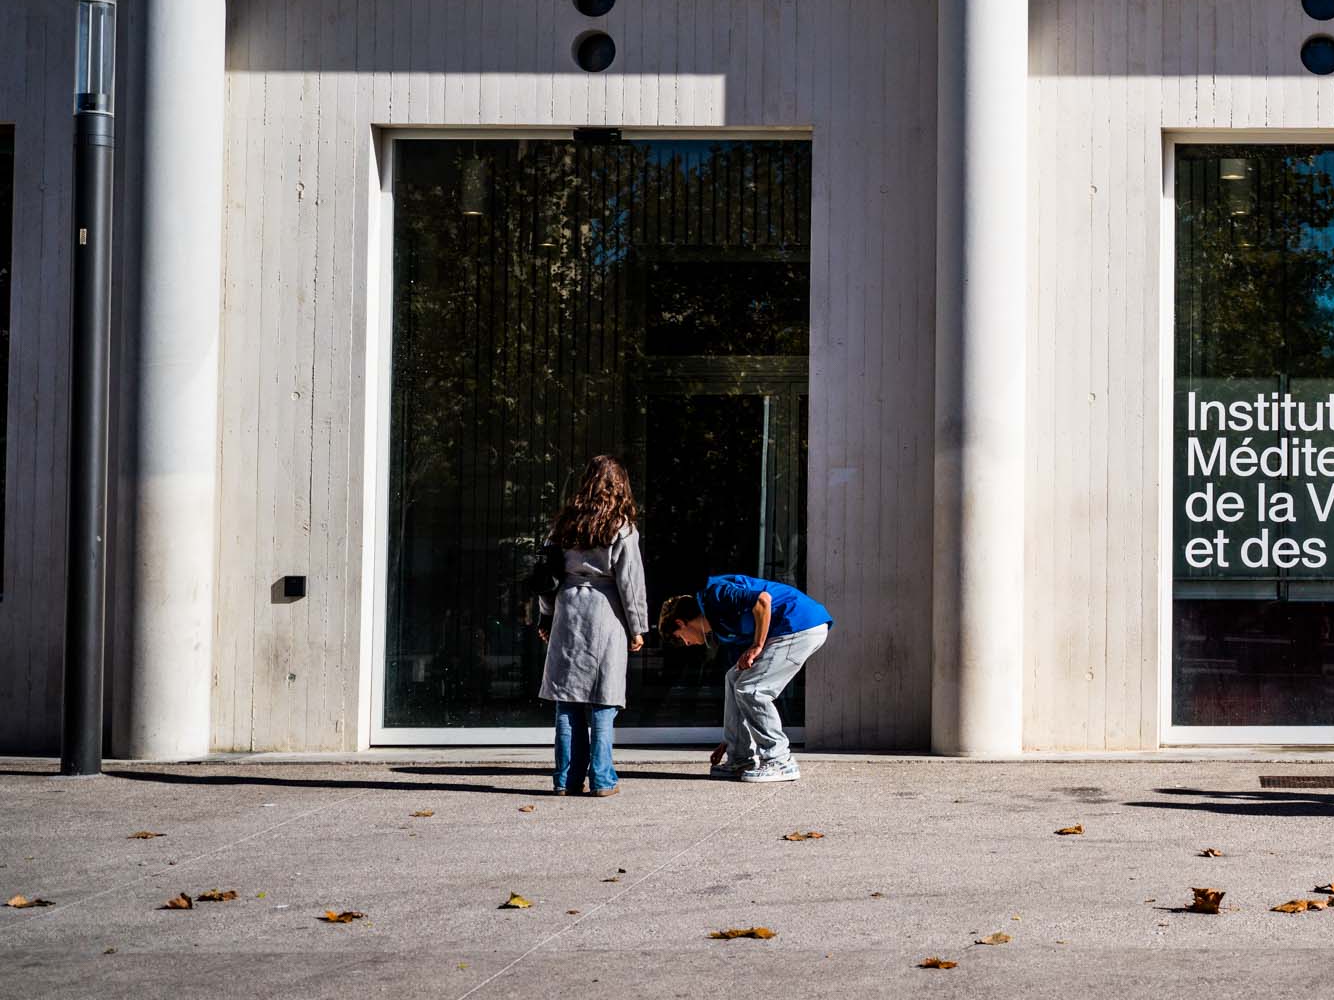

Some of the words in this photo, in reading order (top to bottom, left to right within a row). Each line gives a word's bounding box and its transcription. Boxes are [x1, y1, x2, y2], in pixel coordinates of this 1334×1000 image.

[1185, 482, 1245, 523] de
[1257, 482, 1297, 523] la
[1184, 528, 1230, 569] et
[1240, 527, 1328, 569] des
